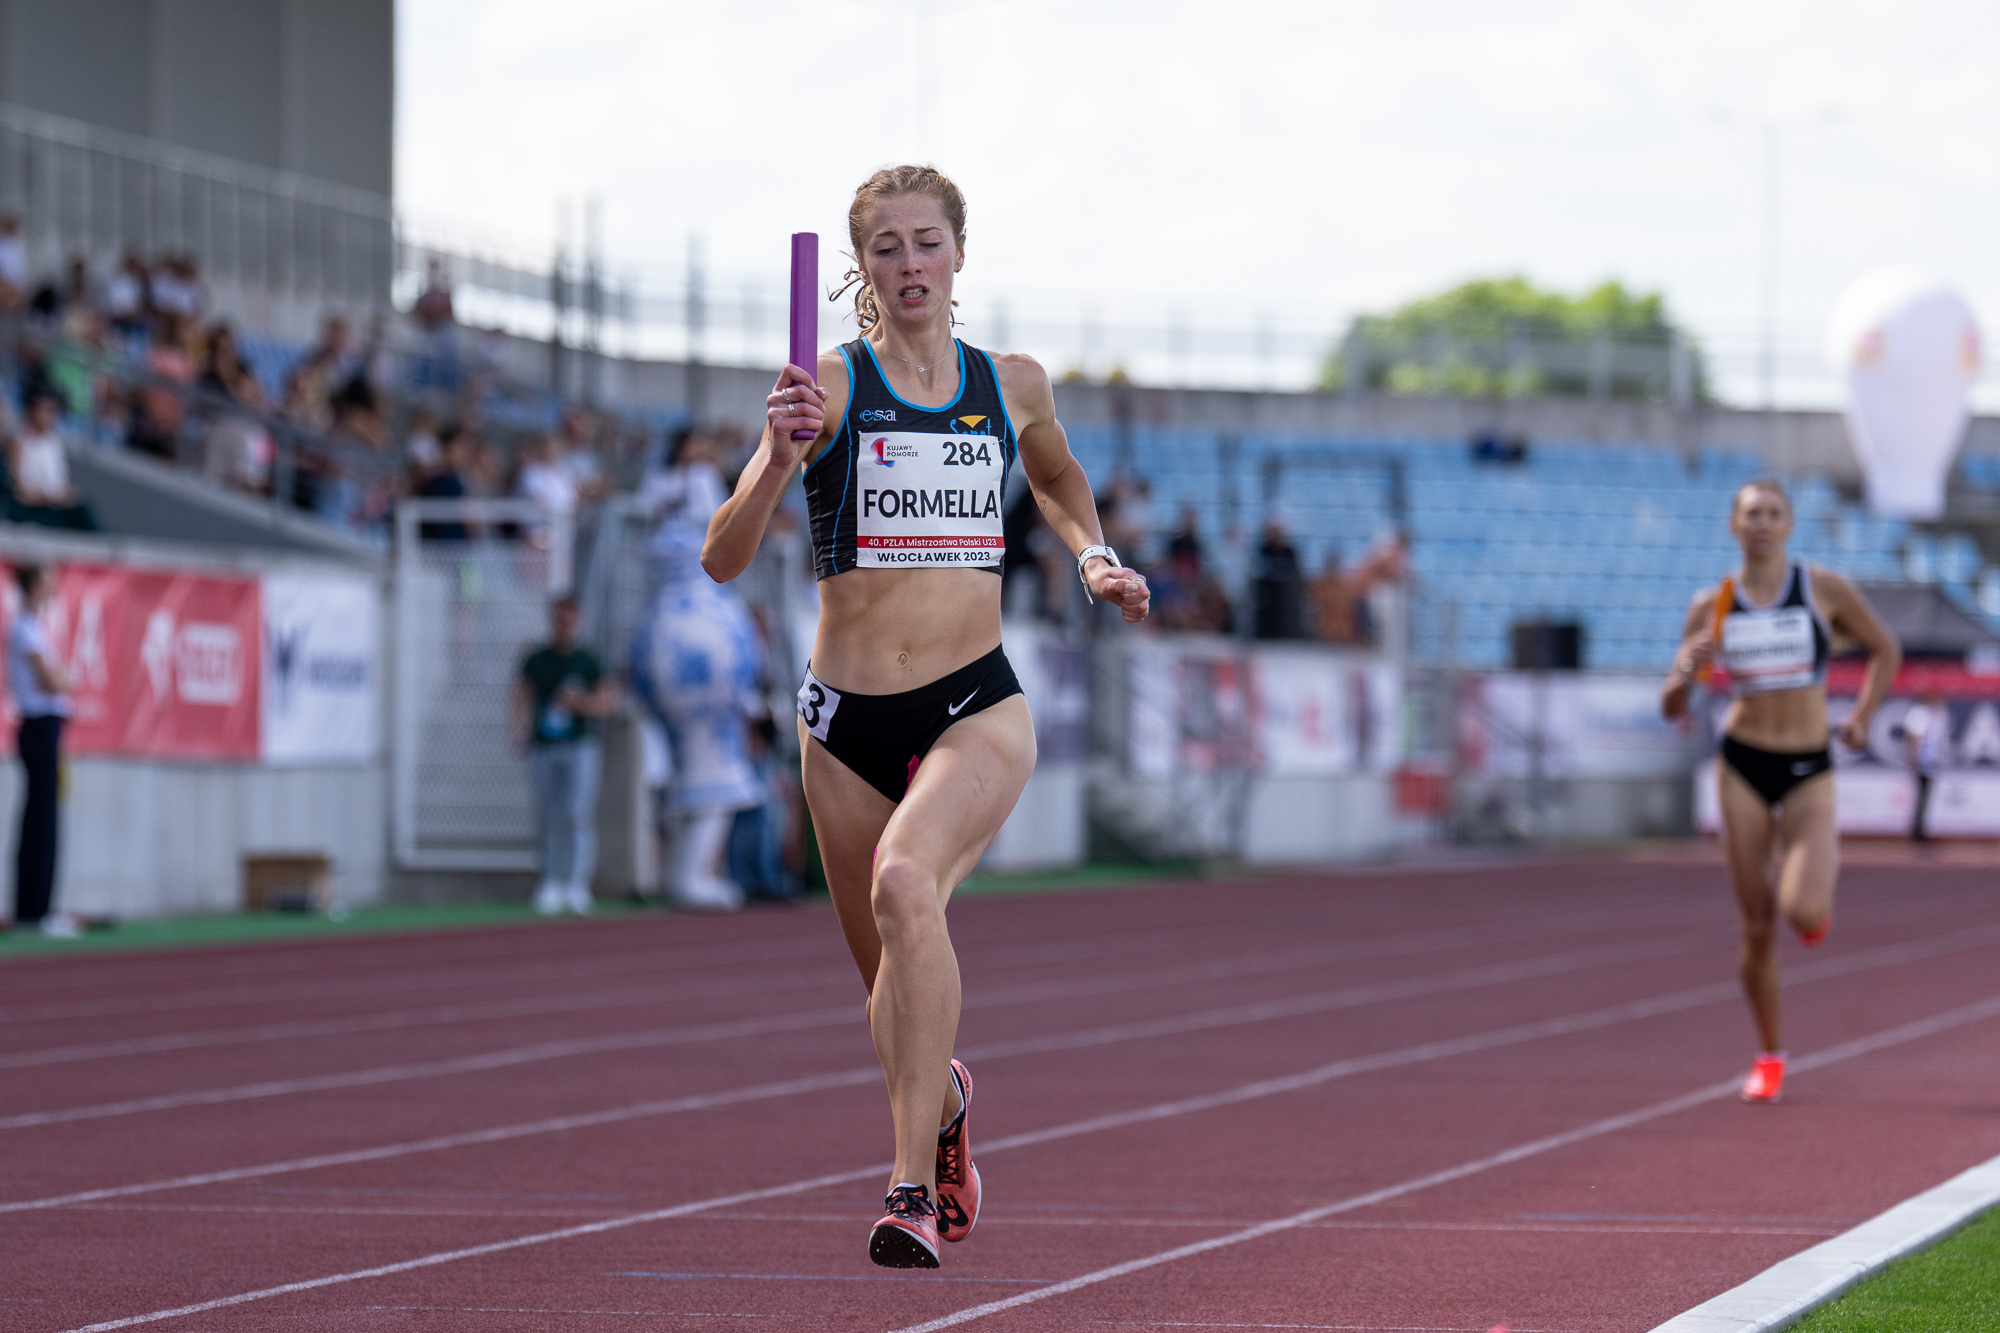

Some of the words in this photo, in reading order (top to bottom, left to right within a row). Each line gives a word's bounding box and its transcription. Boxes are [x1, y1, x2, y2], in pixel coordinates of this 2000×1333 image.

[942, 441, 991, 466] 284
[863, 489, 999, 519] FORMELLA
[868, 538, 881, 547] 40.
[883, 538, 905, 547] PZLA
[907, 537, 958, 547] Mistrzostwa
[959, 537, 981, 546] Polski
[982, 538, 997, 546] U23
[877, 552, 961, 562] WŁOCŁAWEK
[964, 551, 991, 561] 2023
[803, 683, 826, 728] 3
